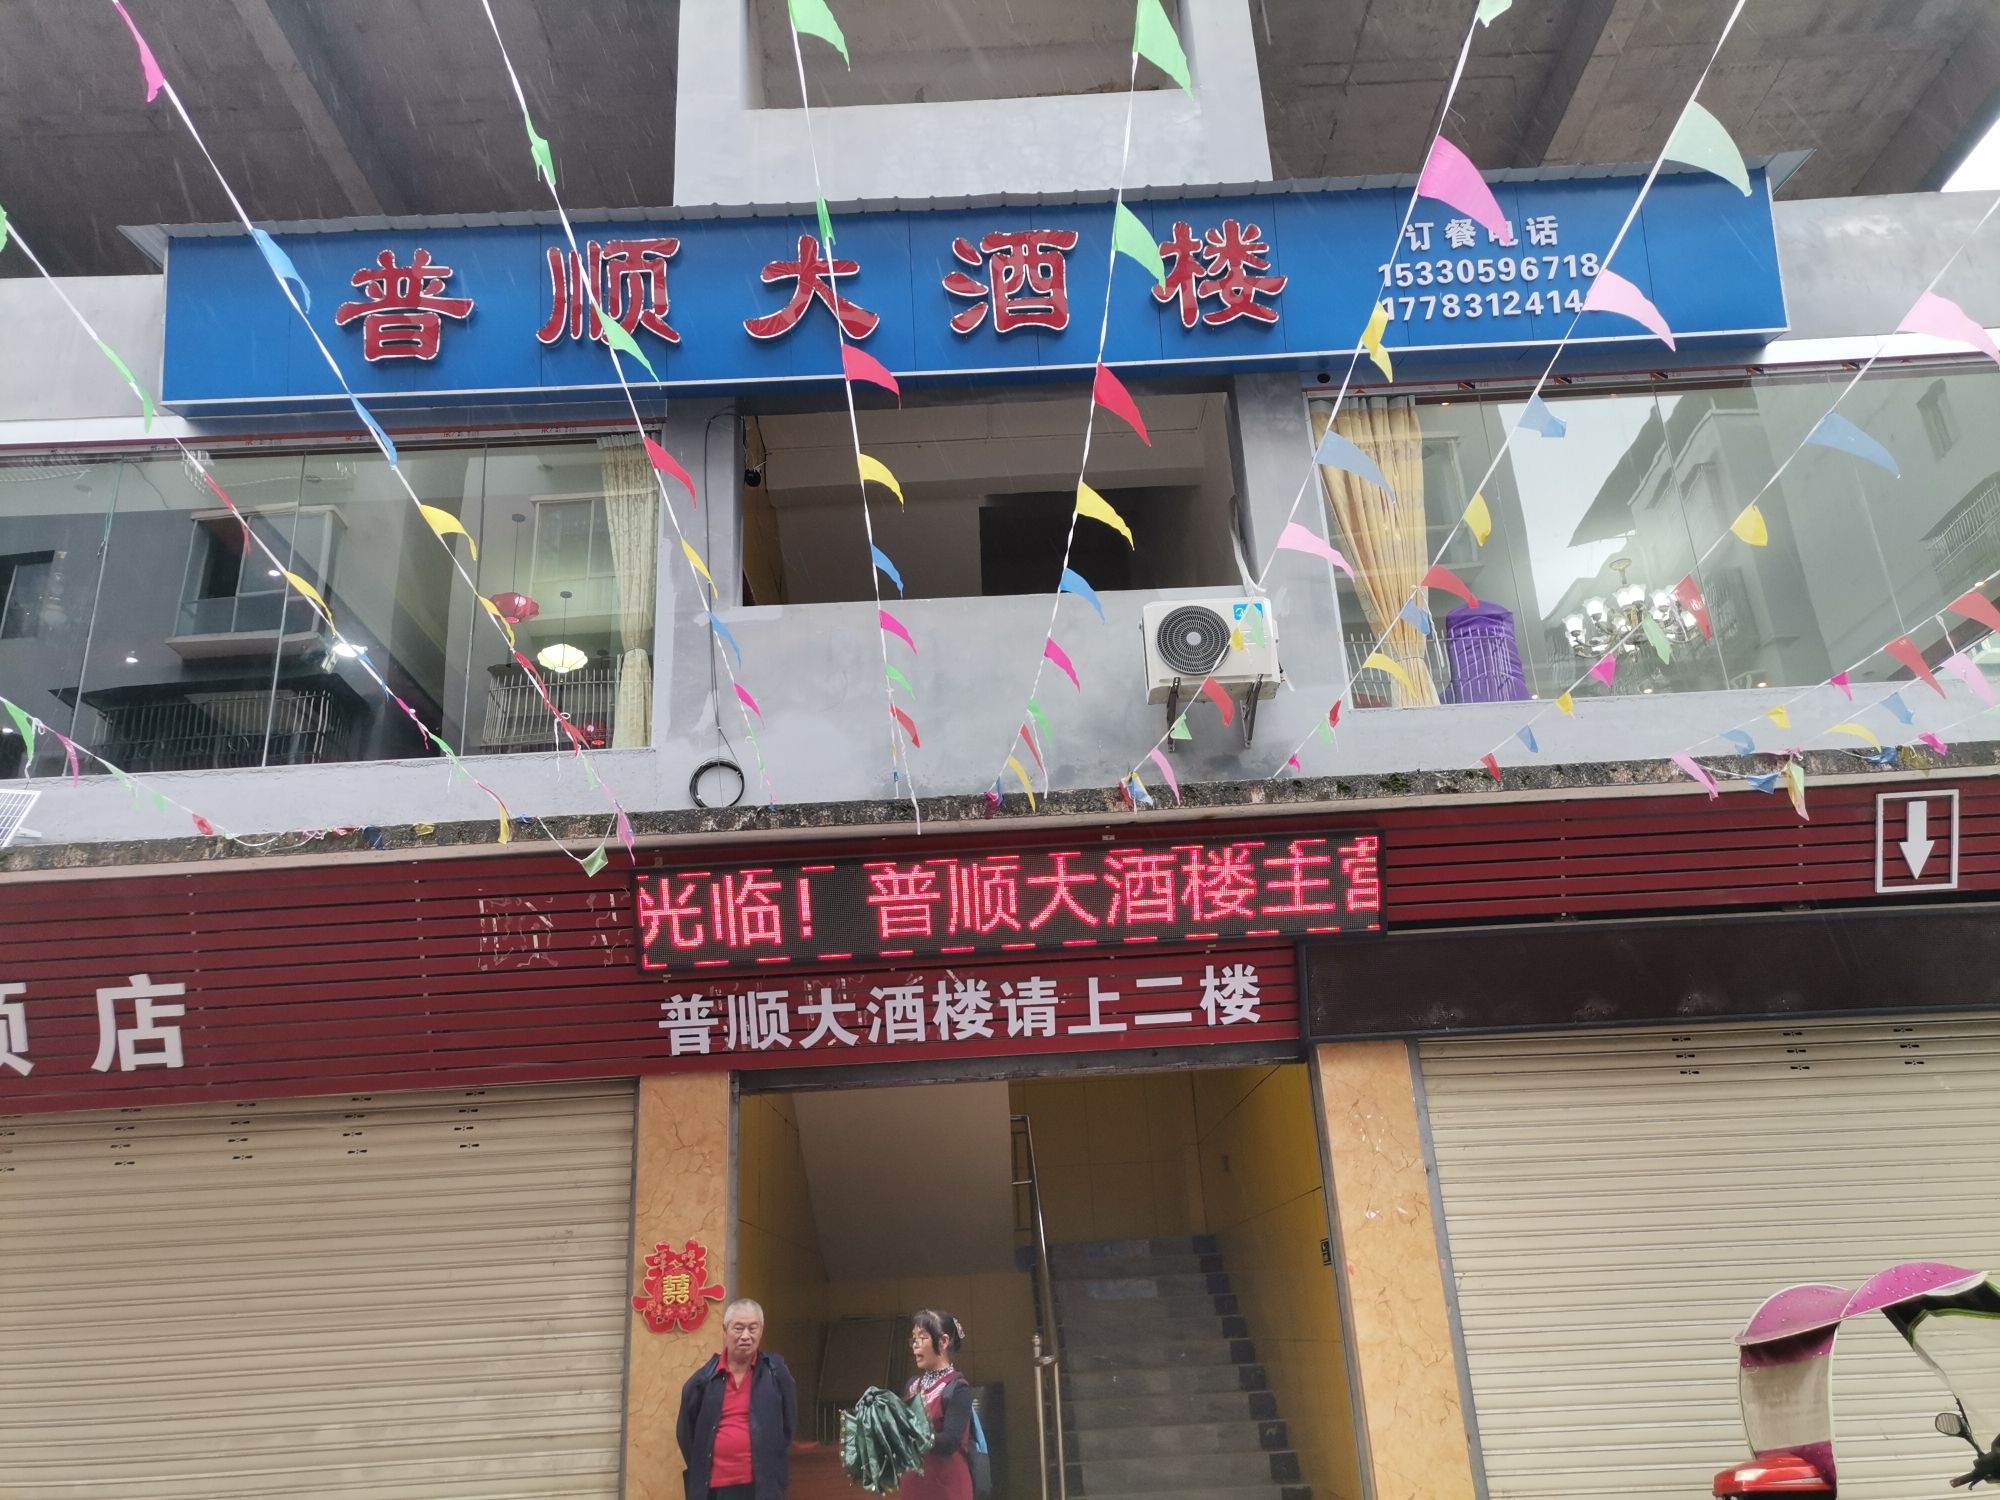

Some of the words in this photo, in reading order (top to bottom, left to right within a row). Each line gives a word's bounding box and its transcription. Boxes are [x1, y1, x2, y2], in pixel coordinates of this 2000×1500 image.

[334, 219, 1288, 364] 普顺大酒楼
[1378, 252, 1600, 287] 15330596718
[1382, 289, 1590, 321] 1778312414
[659, 963, 1262, 1055] 普顺大酒楼请上二楼
